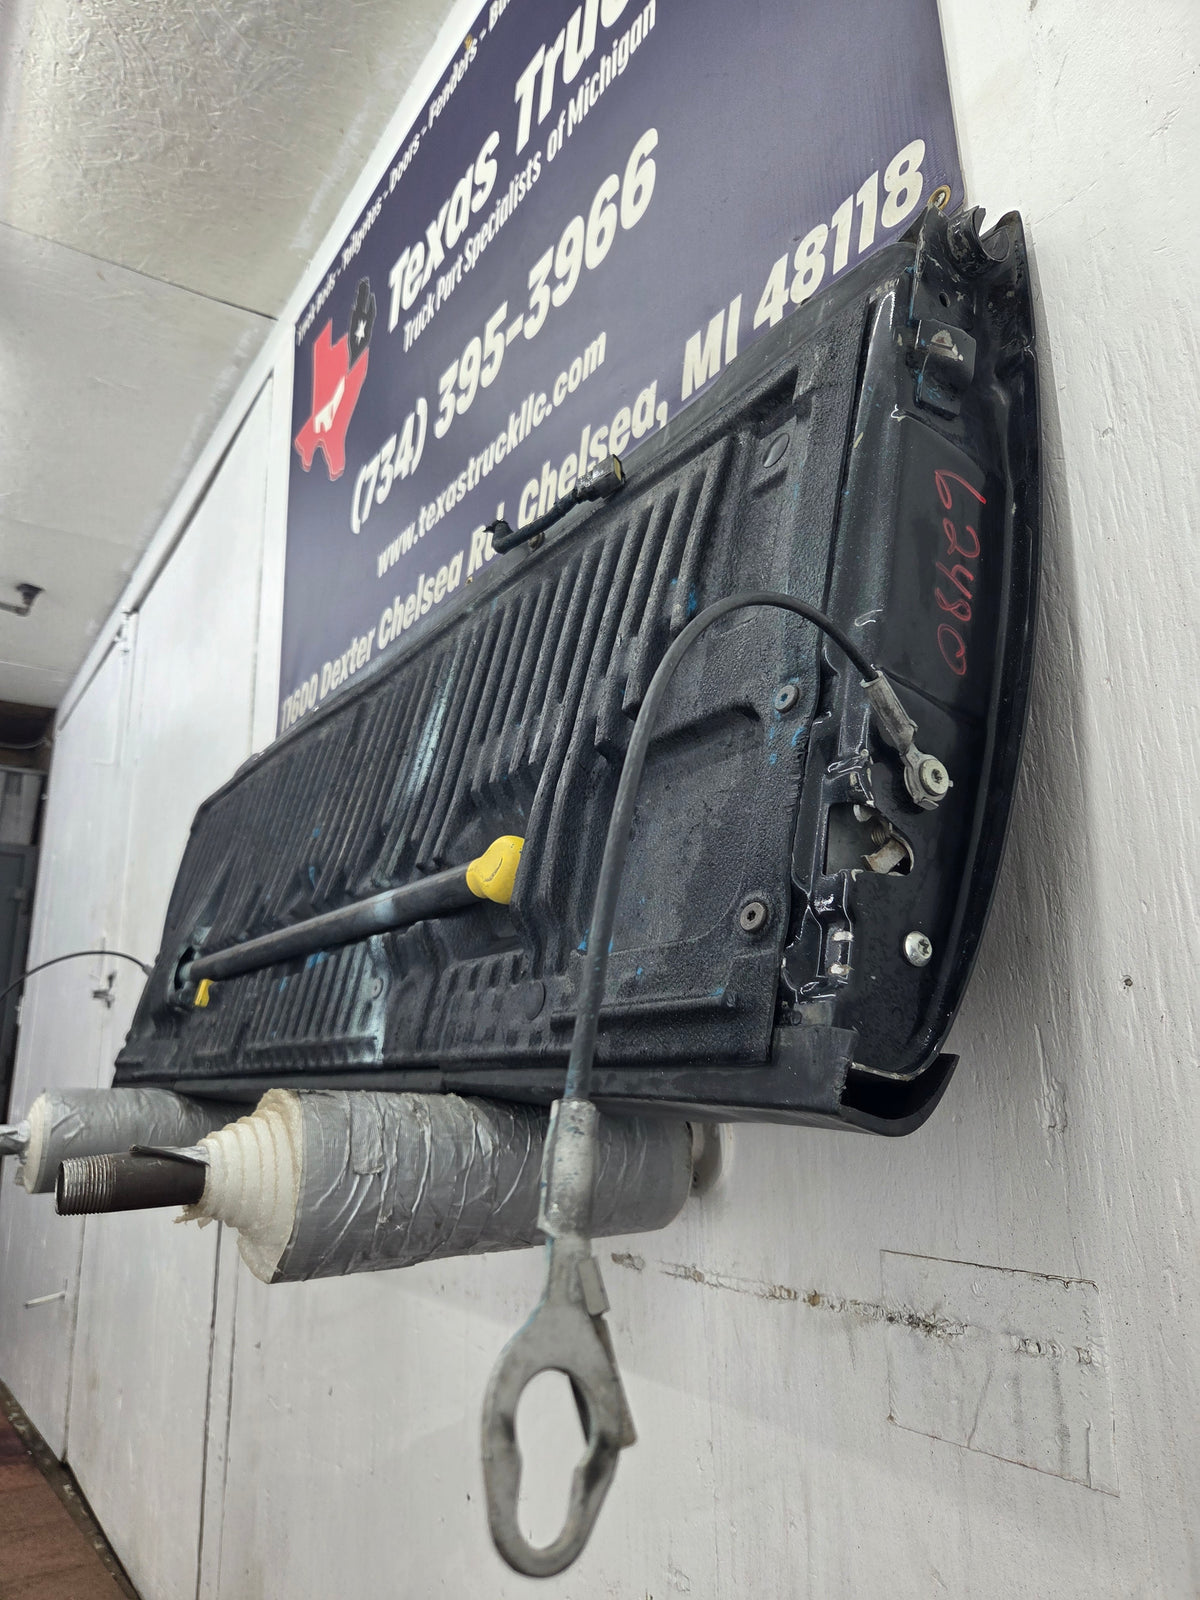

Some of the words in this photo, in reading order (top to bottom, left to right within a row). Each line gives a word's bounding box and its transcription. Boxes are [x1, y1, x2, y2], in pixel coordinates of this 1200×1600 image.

[388, 130, 500, 333] Texas
[390, 133, 420, 193] Doors
[428, 38, 478, 130] Fenders
[403, 293, 435, 351] Truck
[434, 254, 463, 311] Part
[463, 151, 541, 273] Specialists
[547, 109, 566, 162] of
[567, 0, 656, 137] Michigan
[320, 626, 376, 700] Dexter
[378, 551, 464, 650] Chelsea
[517, 379, 669, 531] Chelsea,
[681, 292, 742, 402] MI
[753, 138, 926, 330] 48118
[351, 397, 428, 534] (734)
[434, 127, 659, 440] 395-3966
[376, 331, 607, 578] www.texastruckllc.com
[934, 468, 987, 676] 62480
